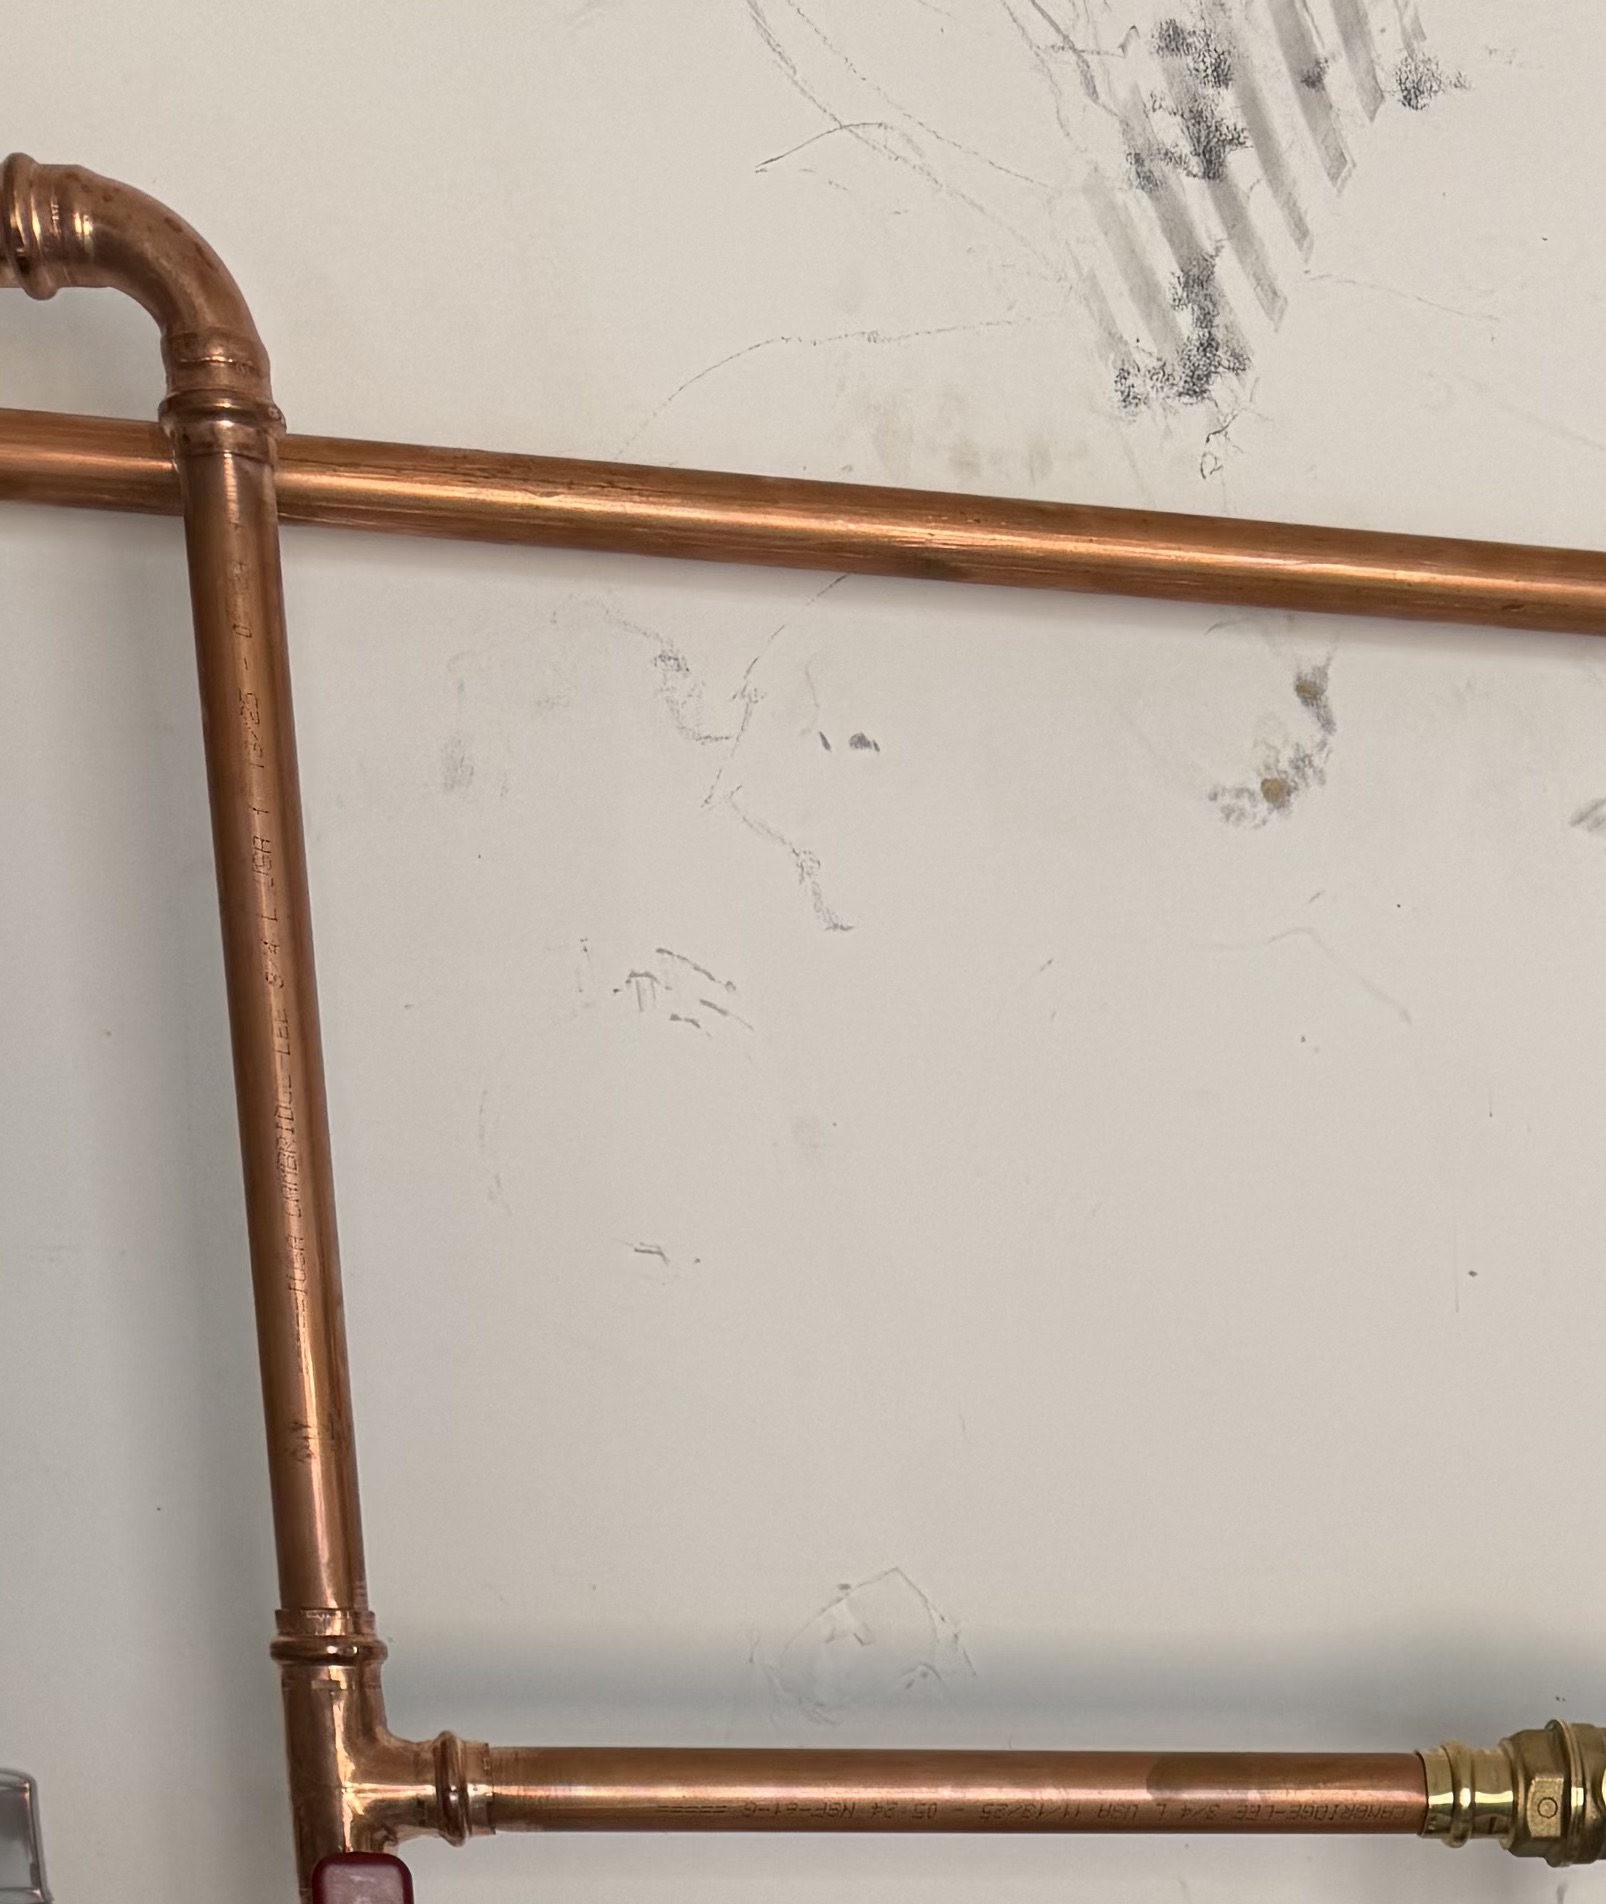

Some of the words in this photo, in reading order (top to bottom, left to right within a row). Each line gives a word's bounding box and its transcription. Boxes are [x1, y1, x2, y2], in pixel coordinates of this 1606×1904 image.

[1096, 1802, 1139, 1821] USA
[1155, 1802, 1167, 1821] L
[1177, 1802, 1220, 1821] 3/4
[1232, 1802, 1406, 1822] CAMBRIDGE-LEE
